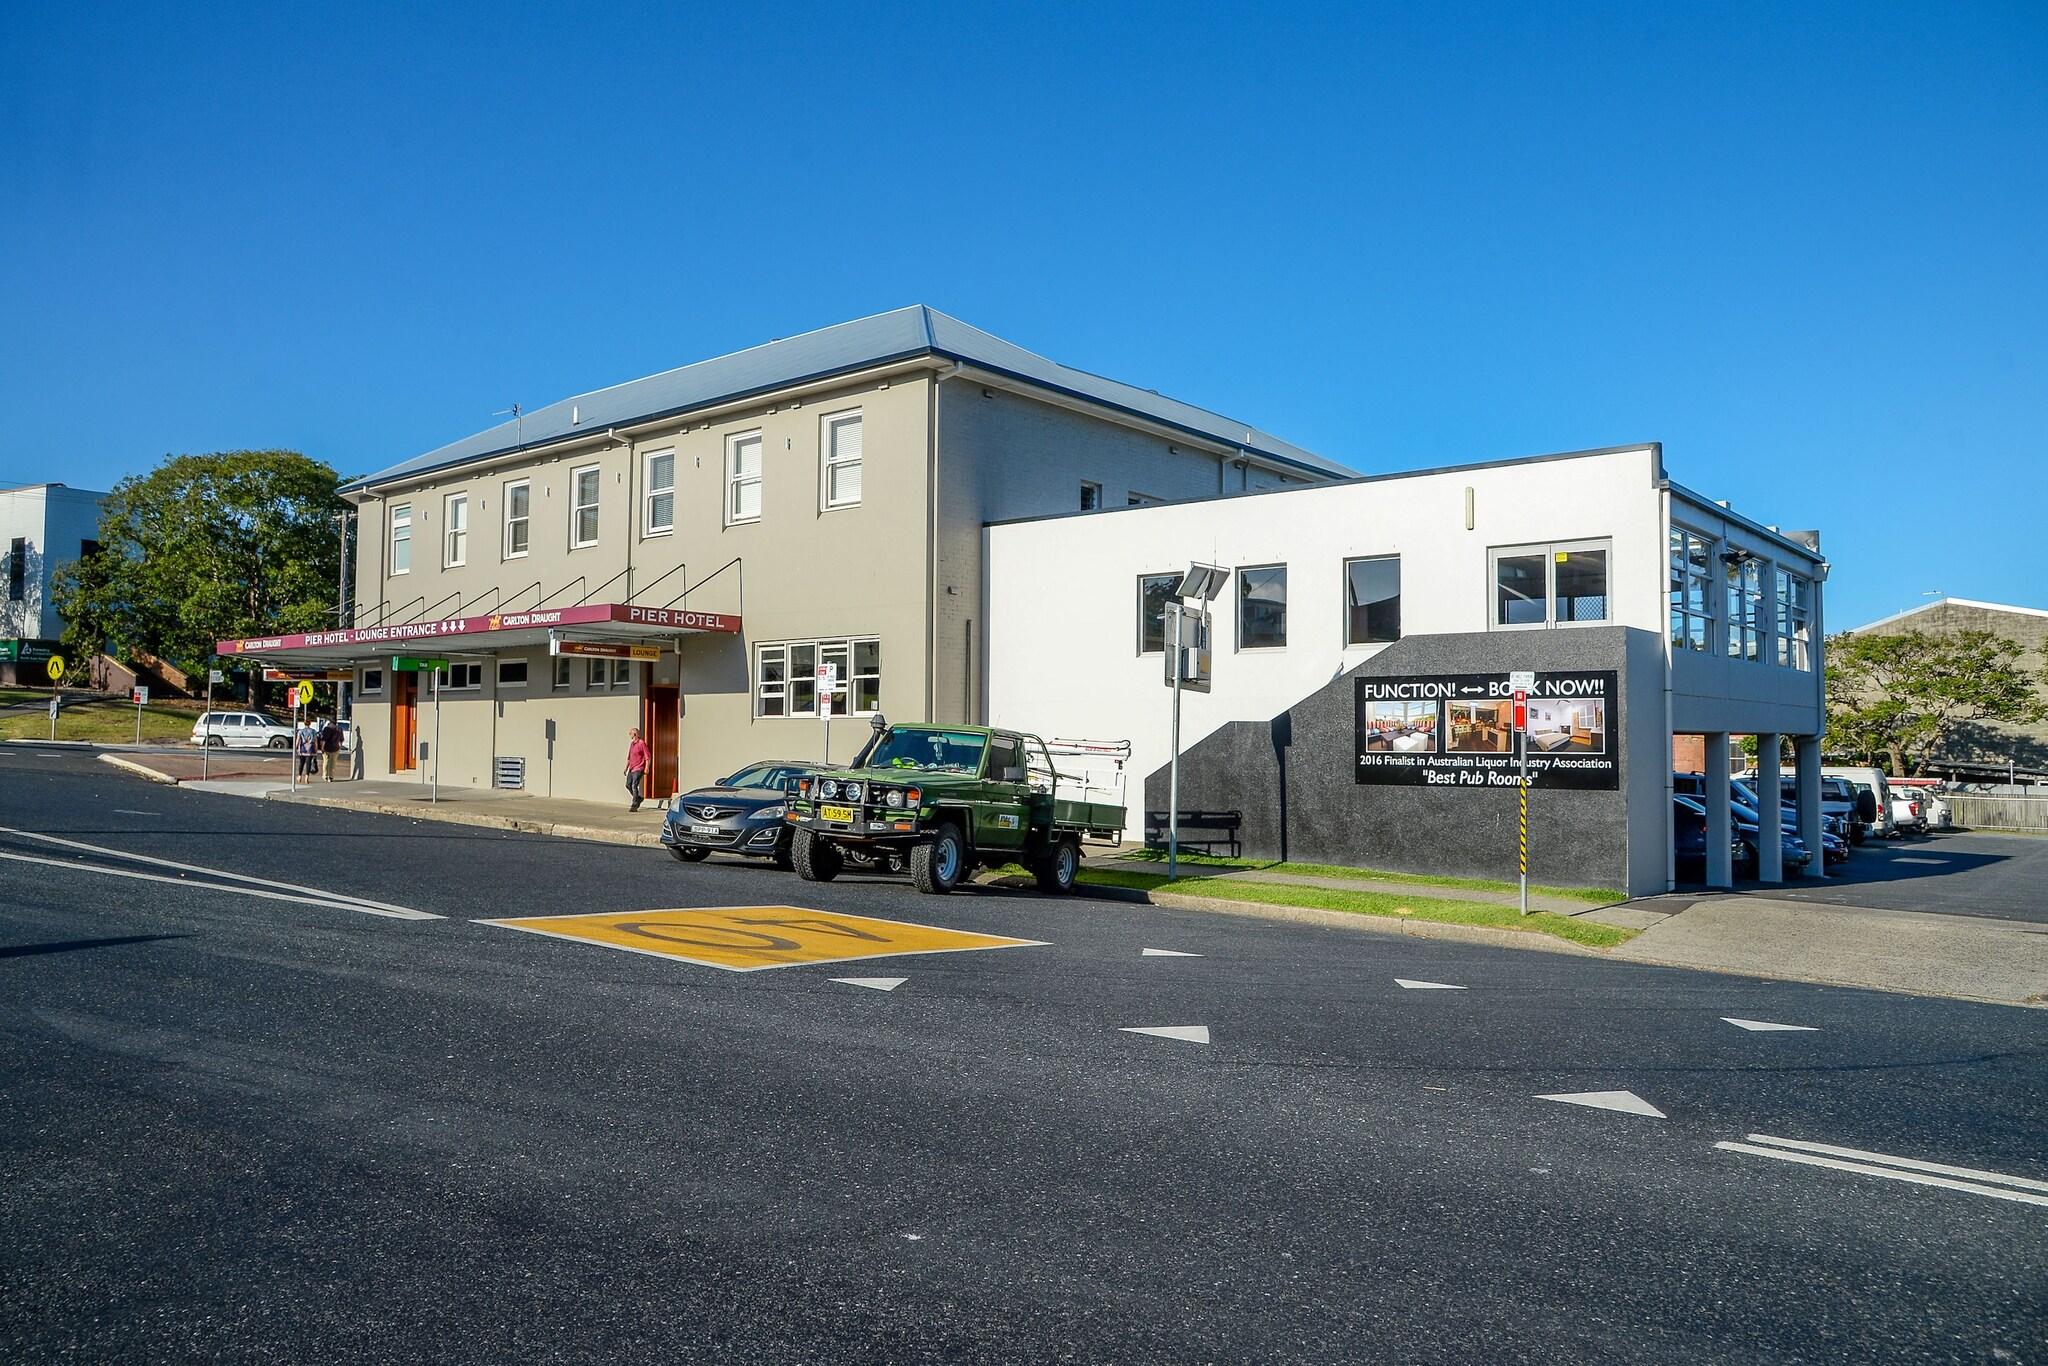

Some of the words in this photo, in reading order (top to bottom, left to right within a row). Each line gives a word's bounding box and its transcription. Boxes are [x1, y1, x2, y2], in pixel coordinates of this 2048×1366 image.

[503, 615, 531, 626] CARLTON
[531, 612, 561, 624] DRAUGHT
[630, 607, 668, 623] PIER
[674, 613, 724, 629] HOTEL
[305, 634, 323, 646] PIER
[325, 632, 349, 645] HOTEL
[355, 628, 389, 641] LOUNGE
[391, 623, 437, 639] ENTRANCE
[632, 648, 658, 657] LOUNGE
[1365, 682, 1456, 699] FUNCTION!
[1489, 680, 1542, 697] BOK
[1546, 679, 1605, 696] NOW!!
[1360, 755, 1382, 766] 2016
[1384, 755, 1416, 767] Finalist
[1416, 756, 1426, 766] in
[1427, 756, 1473, 767] Australian
[1475, 756, 1508, 770] Liquor
[1552, 757, 1612, 769] Association
[1422, 769, 1456, 785] "Best
[1459, 770, 1484, 786] Pub
